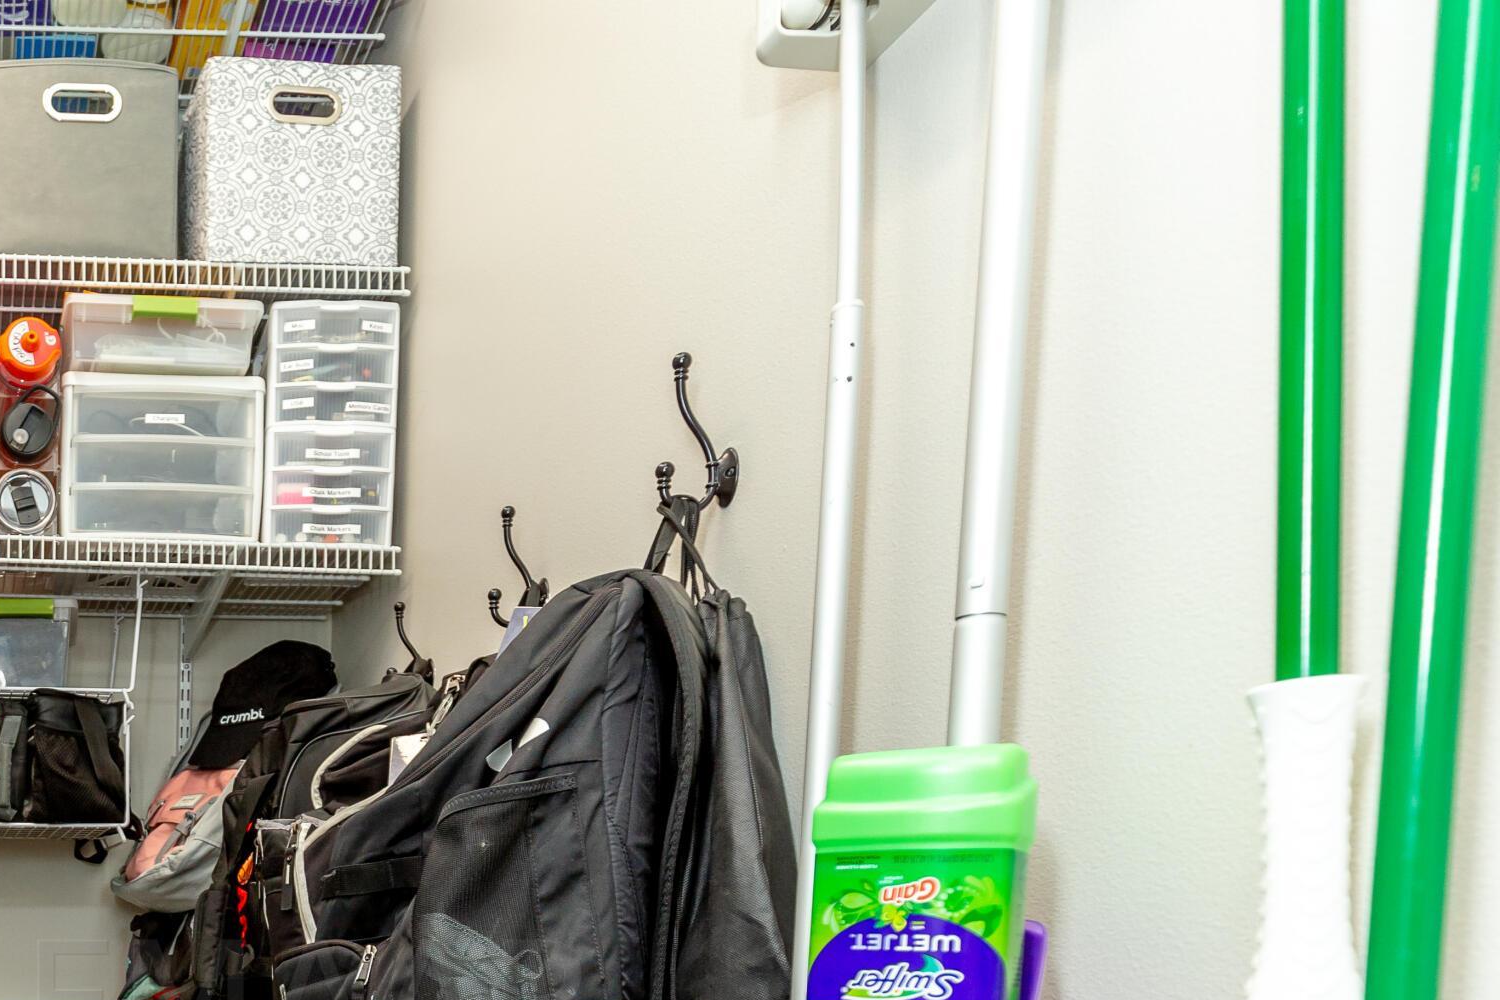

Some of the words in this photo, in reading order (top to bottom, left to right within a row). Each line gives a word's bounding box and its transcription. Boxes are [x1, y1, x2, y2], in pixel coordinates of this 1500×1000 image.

[879, 876, 940, 905] Gain
[850, 934, 962, 952] WETJET
[850, 962, 965, 1000] Swiffer
